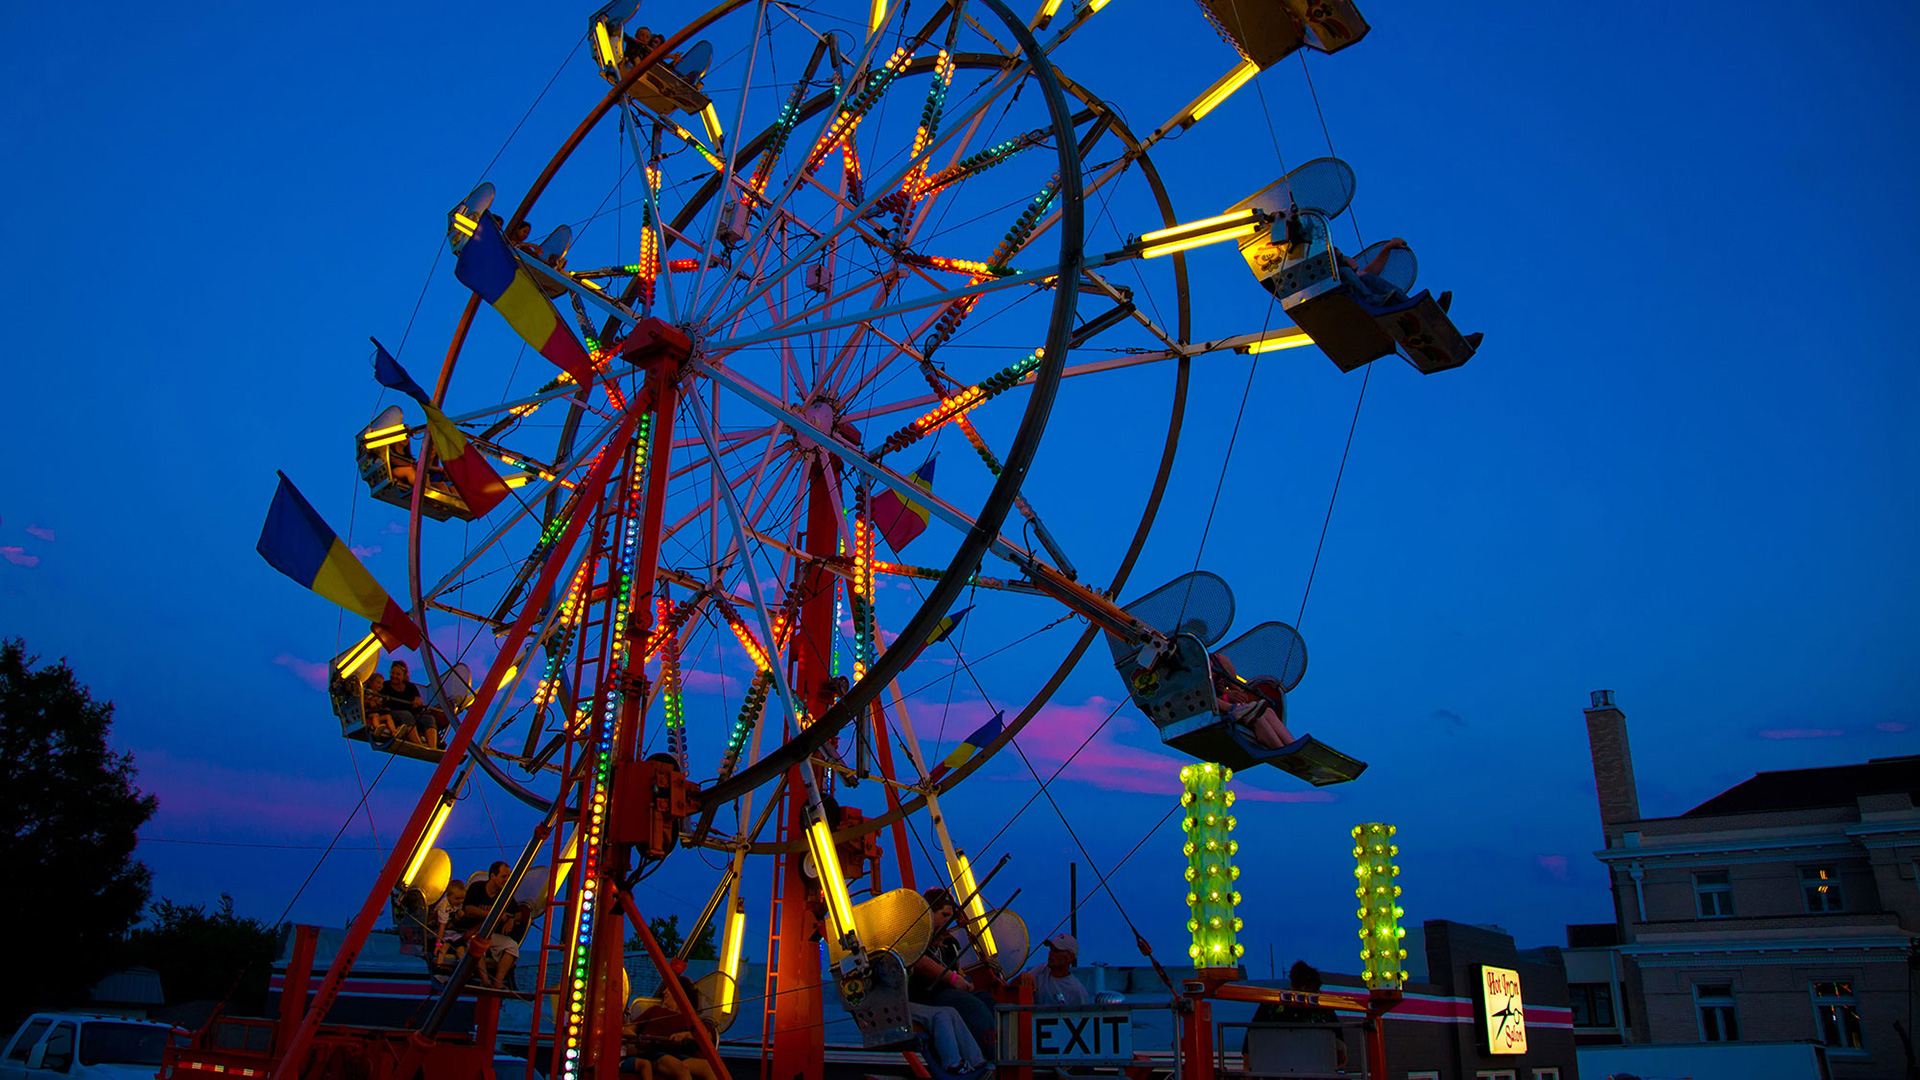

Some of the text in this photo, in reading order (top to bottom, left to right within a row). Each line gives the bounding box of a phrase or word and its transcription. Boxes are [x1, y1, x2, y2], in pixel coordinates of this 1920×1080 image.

[1486, 971, 1519, 997] Hot Iron
[1035, 1016, 1129, 1054] EXIT
[1505, 1024, 1524, 1049] Salon
